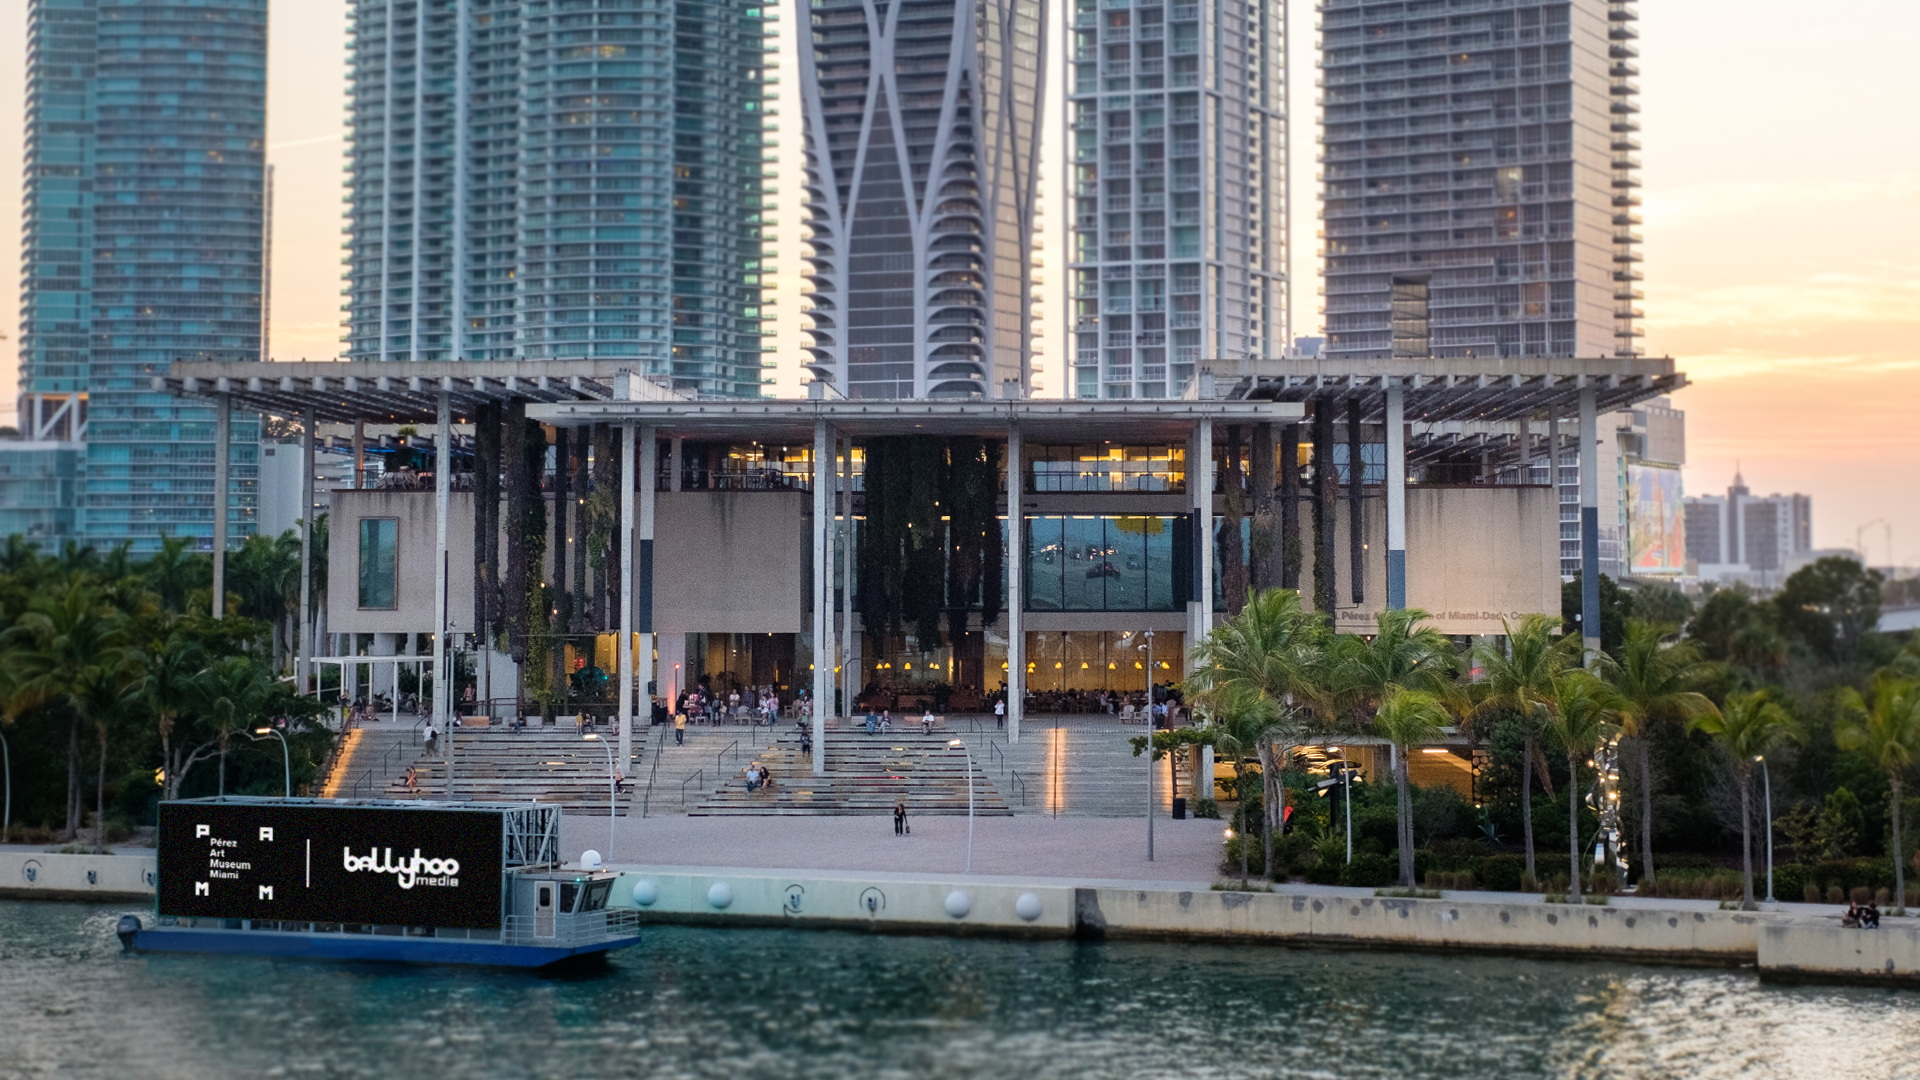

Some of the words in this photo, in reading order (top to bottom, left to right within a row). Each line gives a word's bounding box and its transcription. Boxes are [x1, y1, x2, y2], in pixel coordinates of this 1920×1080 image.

[1341, 610, 1371, 620] Pérez
[1435, 611, 1446, 620] of
[195, 824, 210, 839] P
[258, 826, 274, 842] A
[210, 837, 238, 848] Pérez
[210, 848, 225, 858] Art
[209, 858, 252, 870] Museum
[343, 846, 460, 890] ballyhoo
[209, 869, 239, 879] Miami
[415, 875, 460, 887] media
[194, 881, 210, 897] M
[258, 884, 274, 901] M
